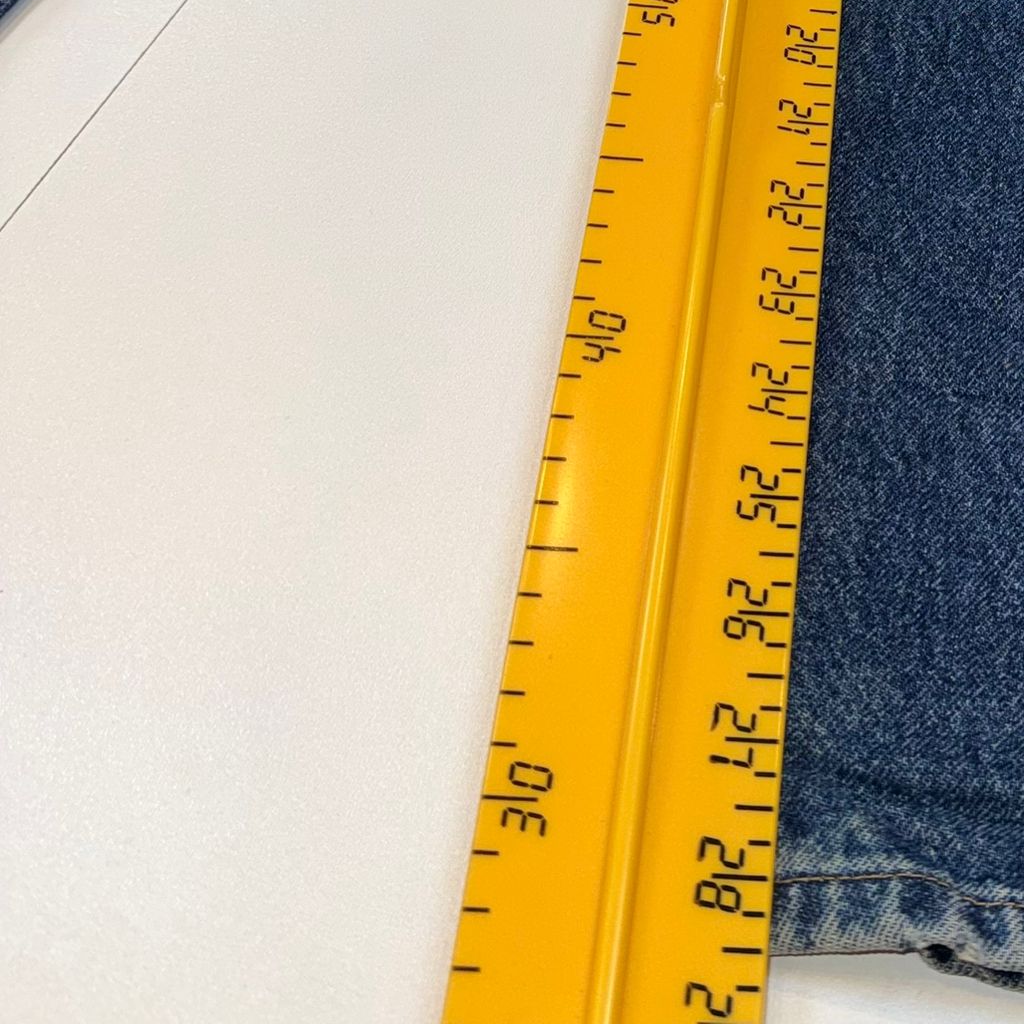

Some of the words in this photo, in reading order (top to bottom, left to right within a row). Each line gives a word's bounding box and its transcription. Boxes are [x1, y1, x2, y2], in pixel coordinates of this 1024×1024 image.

[784, 24, 818, 65] 20
[777, 99, 812, 135] 21
[768, 179, 805, 226] 22
[759, 267, 797, 315] 23
[581, 309, 627, 363] 40
[748, 362, 789, 416] 24
[736, 465, 780, 522] 25
[723, 578, 769, 642] 26
[709, 702, 757, 769] 27
[501, 761, 554, 837] 30
[694, 836, 745, 913] 28
